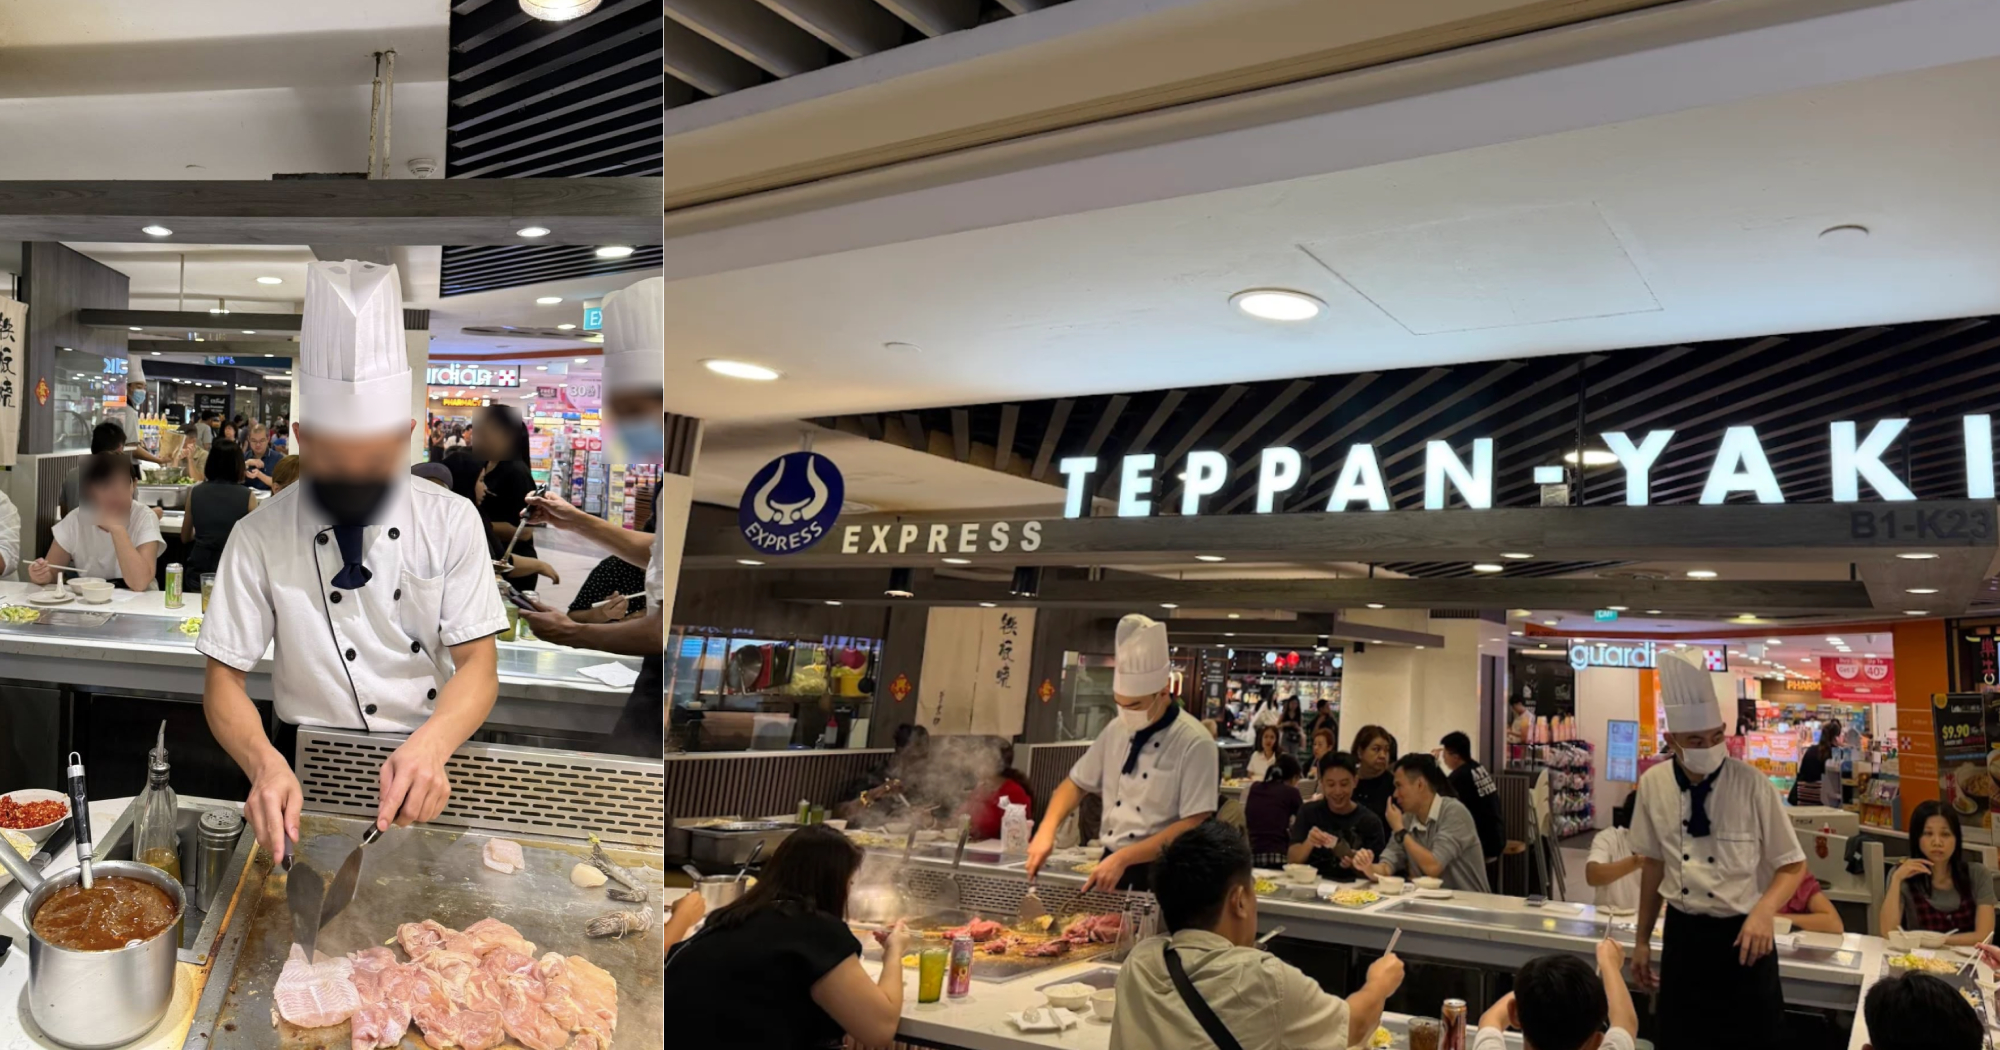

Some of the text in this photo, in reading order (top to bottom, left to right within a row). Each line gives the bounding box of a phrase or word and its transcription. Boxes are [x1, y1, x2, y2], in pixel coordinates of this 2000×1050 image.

[443, 398, 481, 406] PHARMACY
[744, 521, 823, 551] EXPRESS
[841, 521, 1043, 554] EXPRESS
[1851, 507, 1992, 538] B1-K23
[1570, 641, 1675, 671] guardi
[1942, 724, 1969, 739] $9.90
